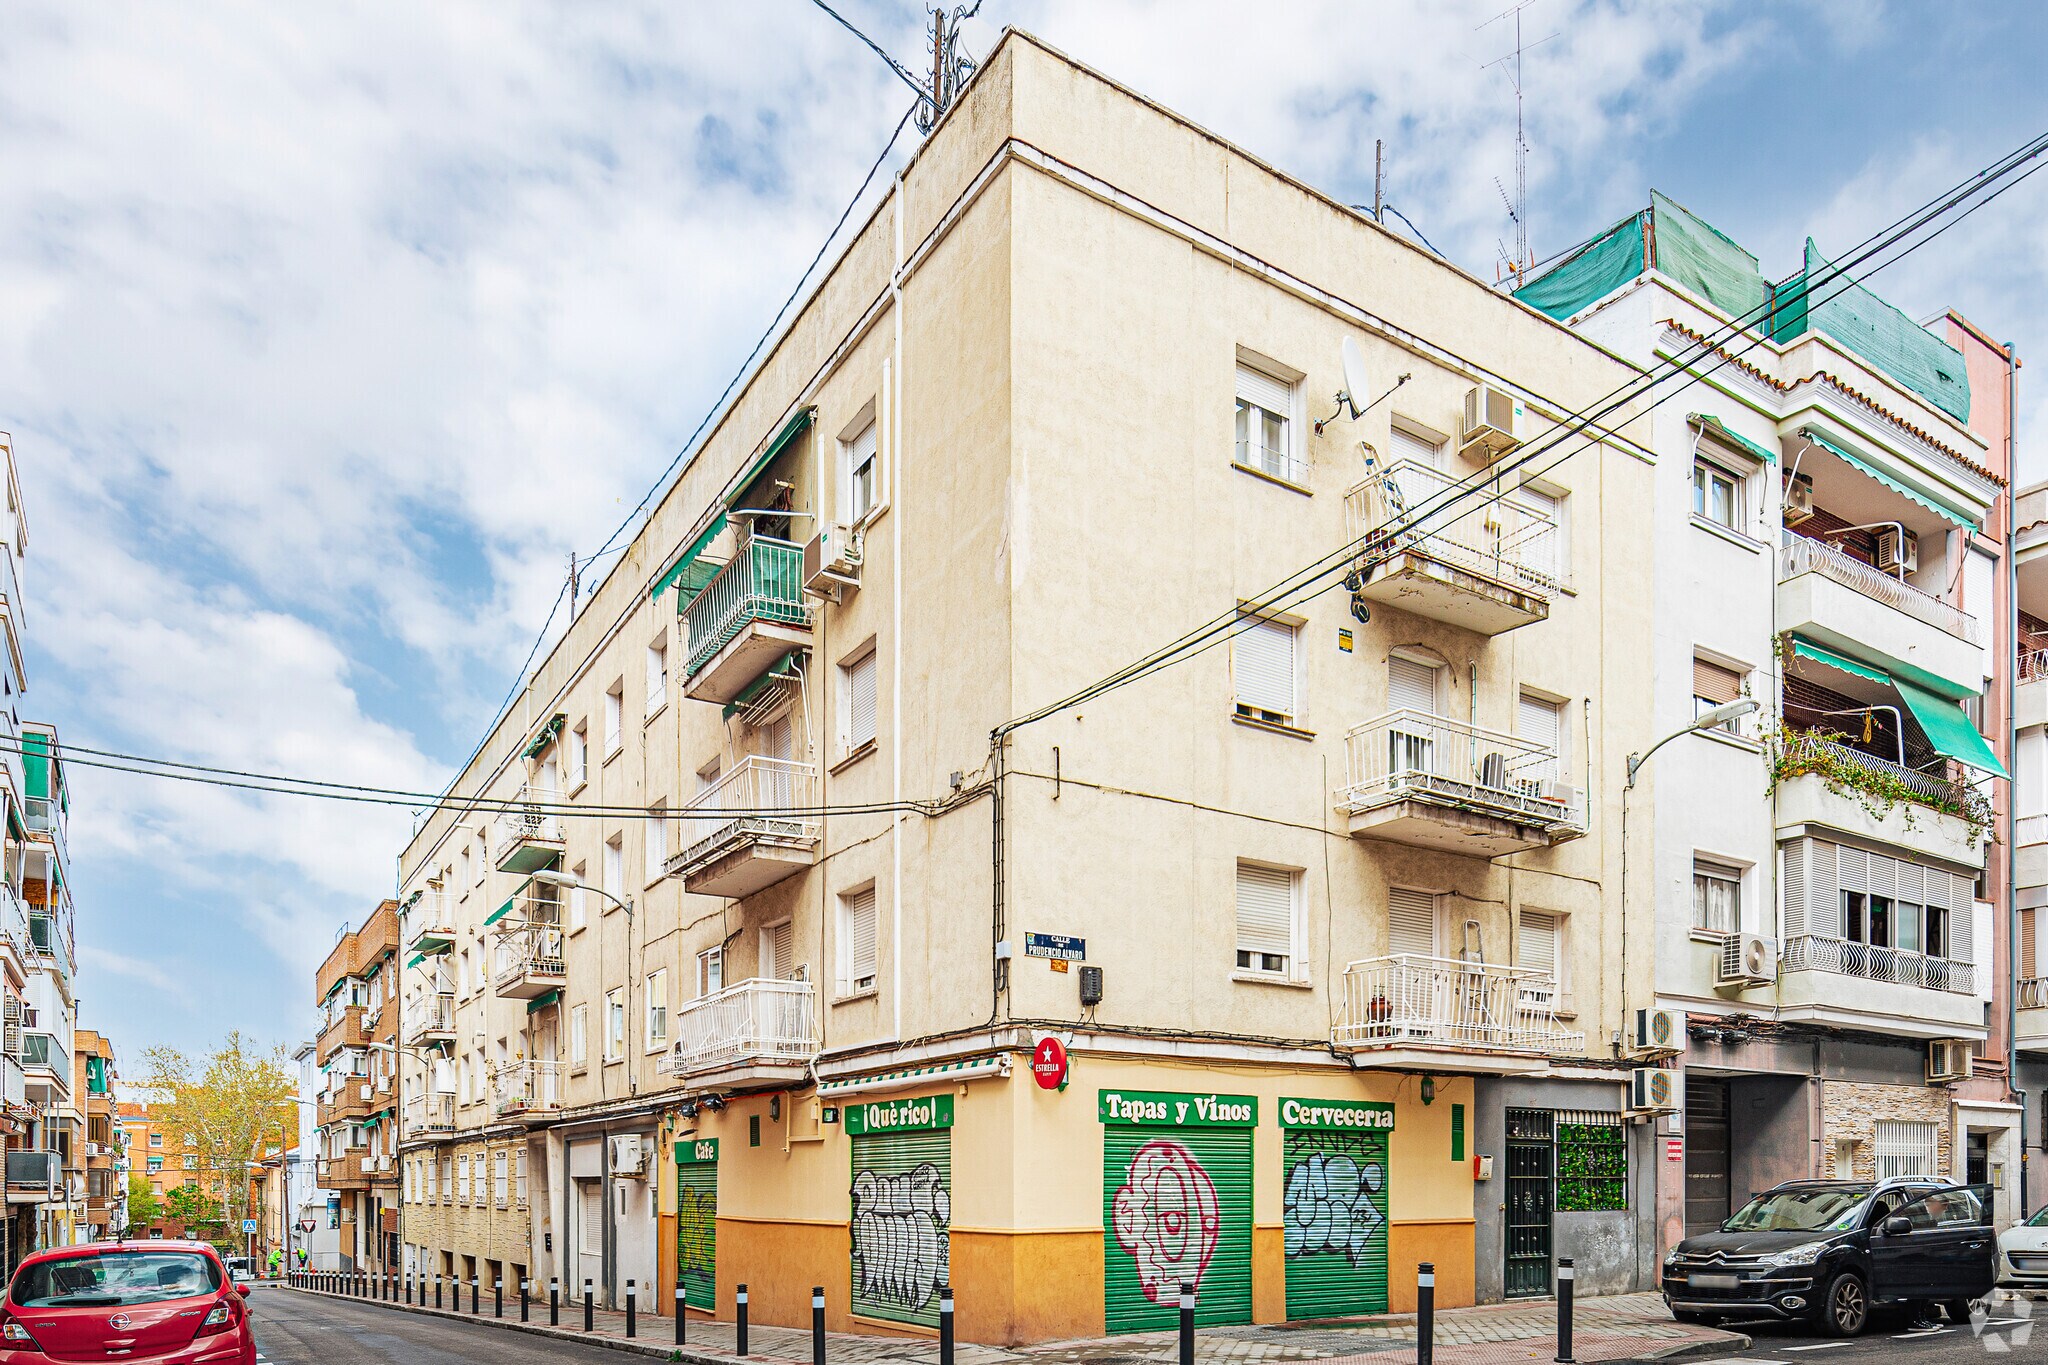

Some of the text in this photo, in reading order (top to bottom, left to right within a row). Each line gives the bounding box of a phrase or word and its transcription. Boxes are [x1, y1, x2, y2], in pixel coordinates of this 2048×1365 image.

[1051, 935, 1071, 944] CALLE
[1028, 945, 1061, 958] PRUDENCIO
[1035, 1063, 1059, 1072] ESTRELLA
[899, 1096, 937, 1128] rico!
[1106, 1094, 1167, 1123] Tapas
[1175, 1101, 1190, 1125] y
[695, 1141, 714, 1160] Cafe
